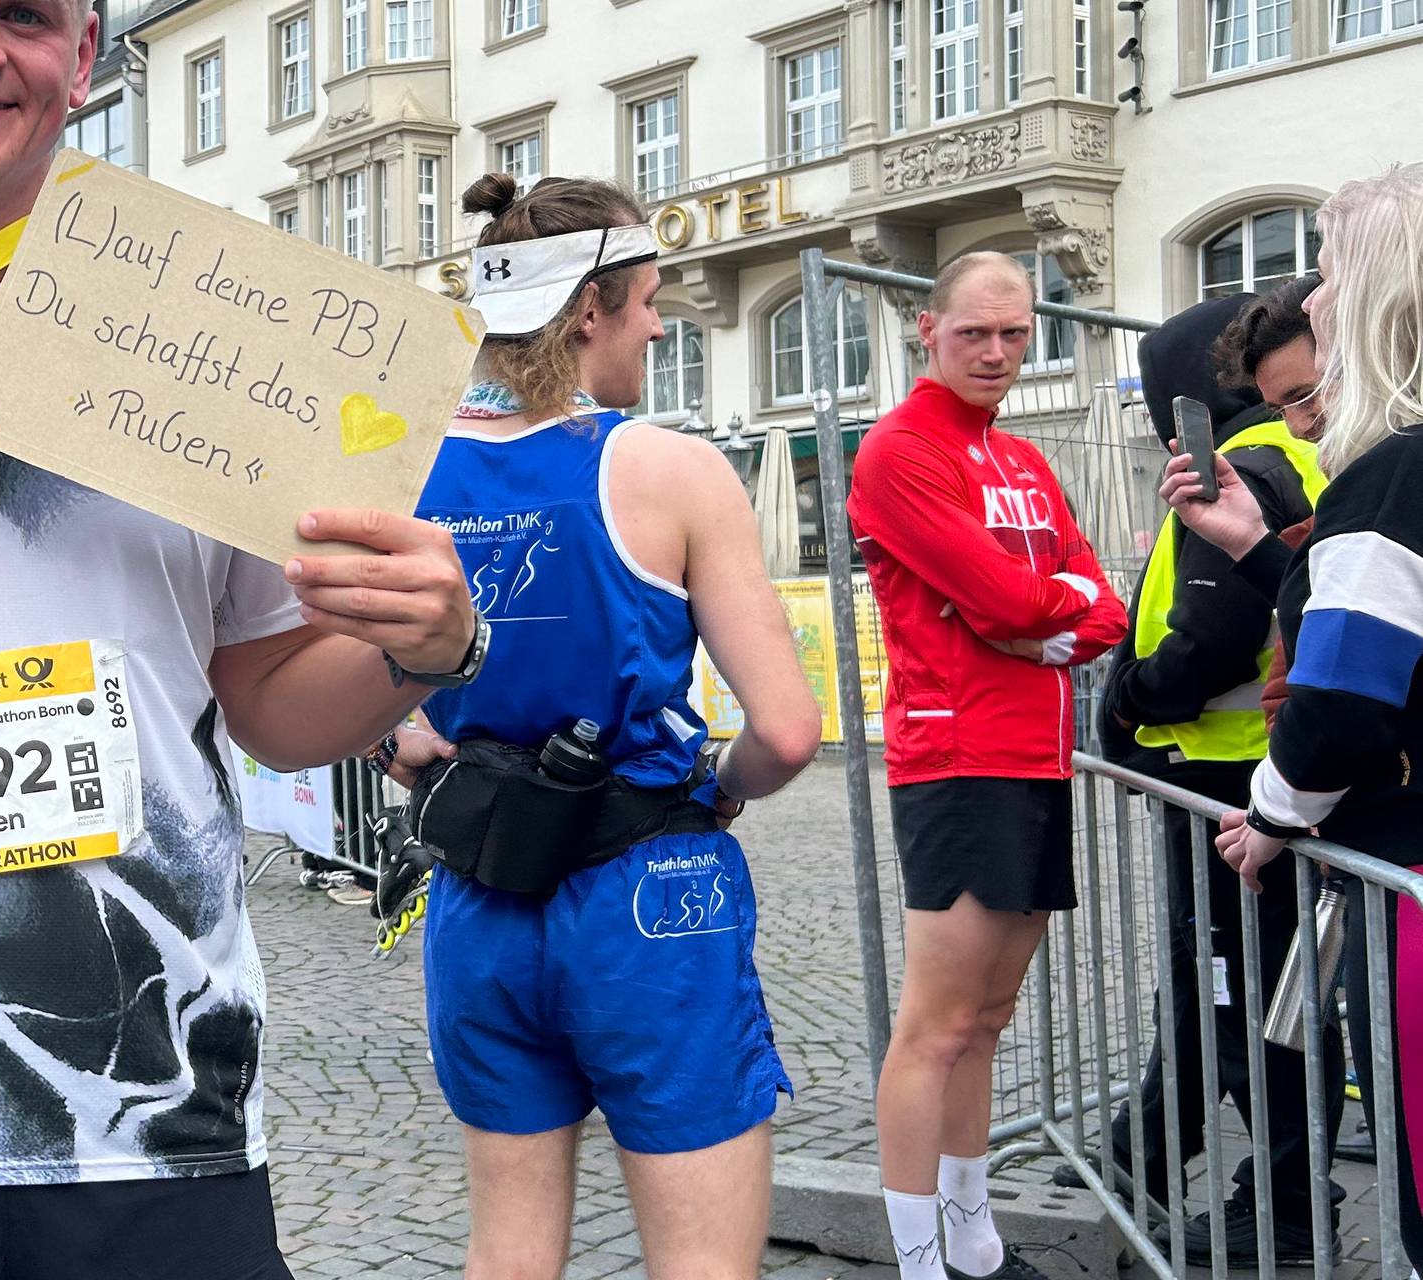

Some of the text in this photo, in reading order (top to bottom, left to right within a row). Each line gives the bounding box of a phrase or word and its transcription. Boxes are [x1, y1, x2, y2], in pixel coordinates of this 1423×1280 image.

[656, 176, 810, 251] OTEL
[53, 191, 408, 382] (L)auf deine PB!
[15, 269, 322, 432] Du schaffst das,
[505, 511, 542, 530] TMK
[38, 704, 74, 718] Bonn
[104, 677, 127, 728] 8692
